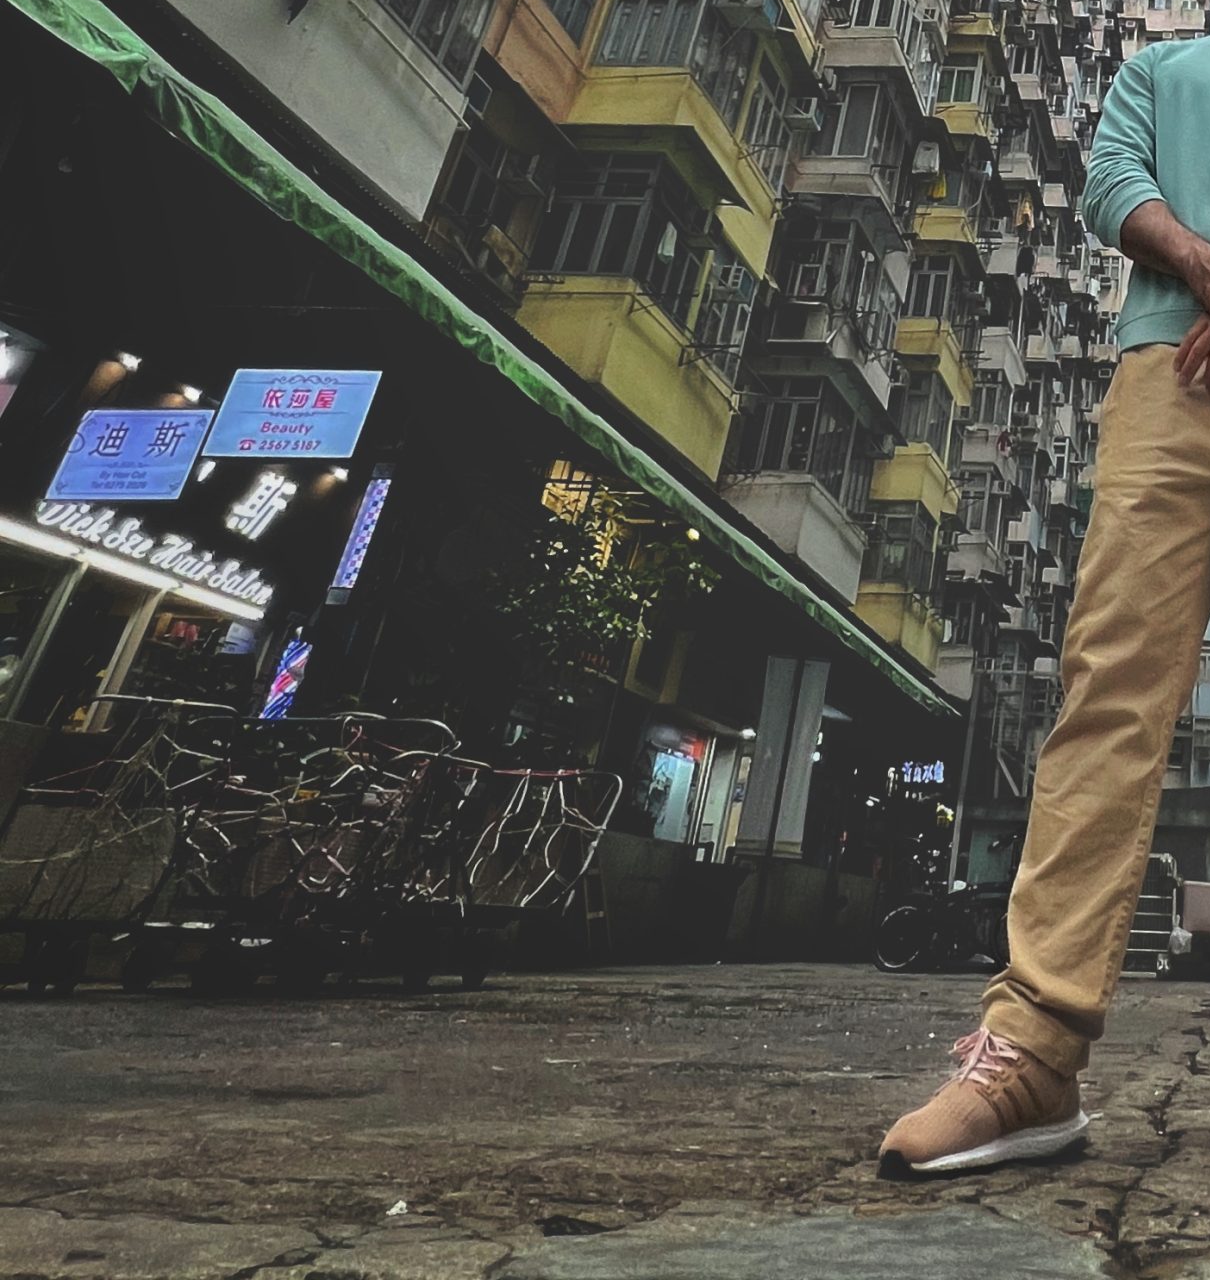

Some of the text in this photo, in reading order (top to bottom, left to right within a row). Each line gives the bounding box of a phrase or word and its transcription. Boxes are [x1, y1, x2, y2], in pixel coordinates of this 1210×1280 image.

[262, 388, 337, 409] 依莎屋
[88, 421, 190, 458] 迪斯
[260, 422, 314, 435] Beauty
[259, 439, 321, 451] 2567 5187
[226, 472, 298, 541] 斯
[150, 533, 217, 581] Hair
[208, 558, 274, 605] Salon
